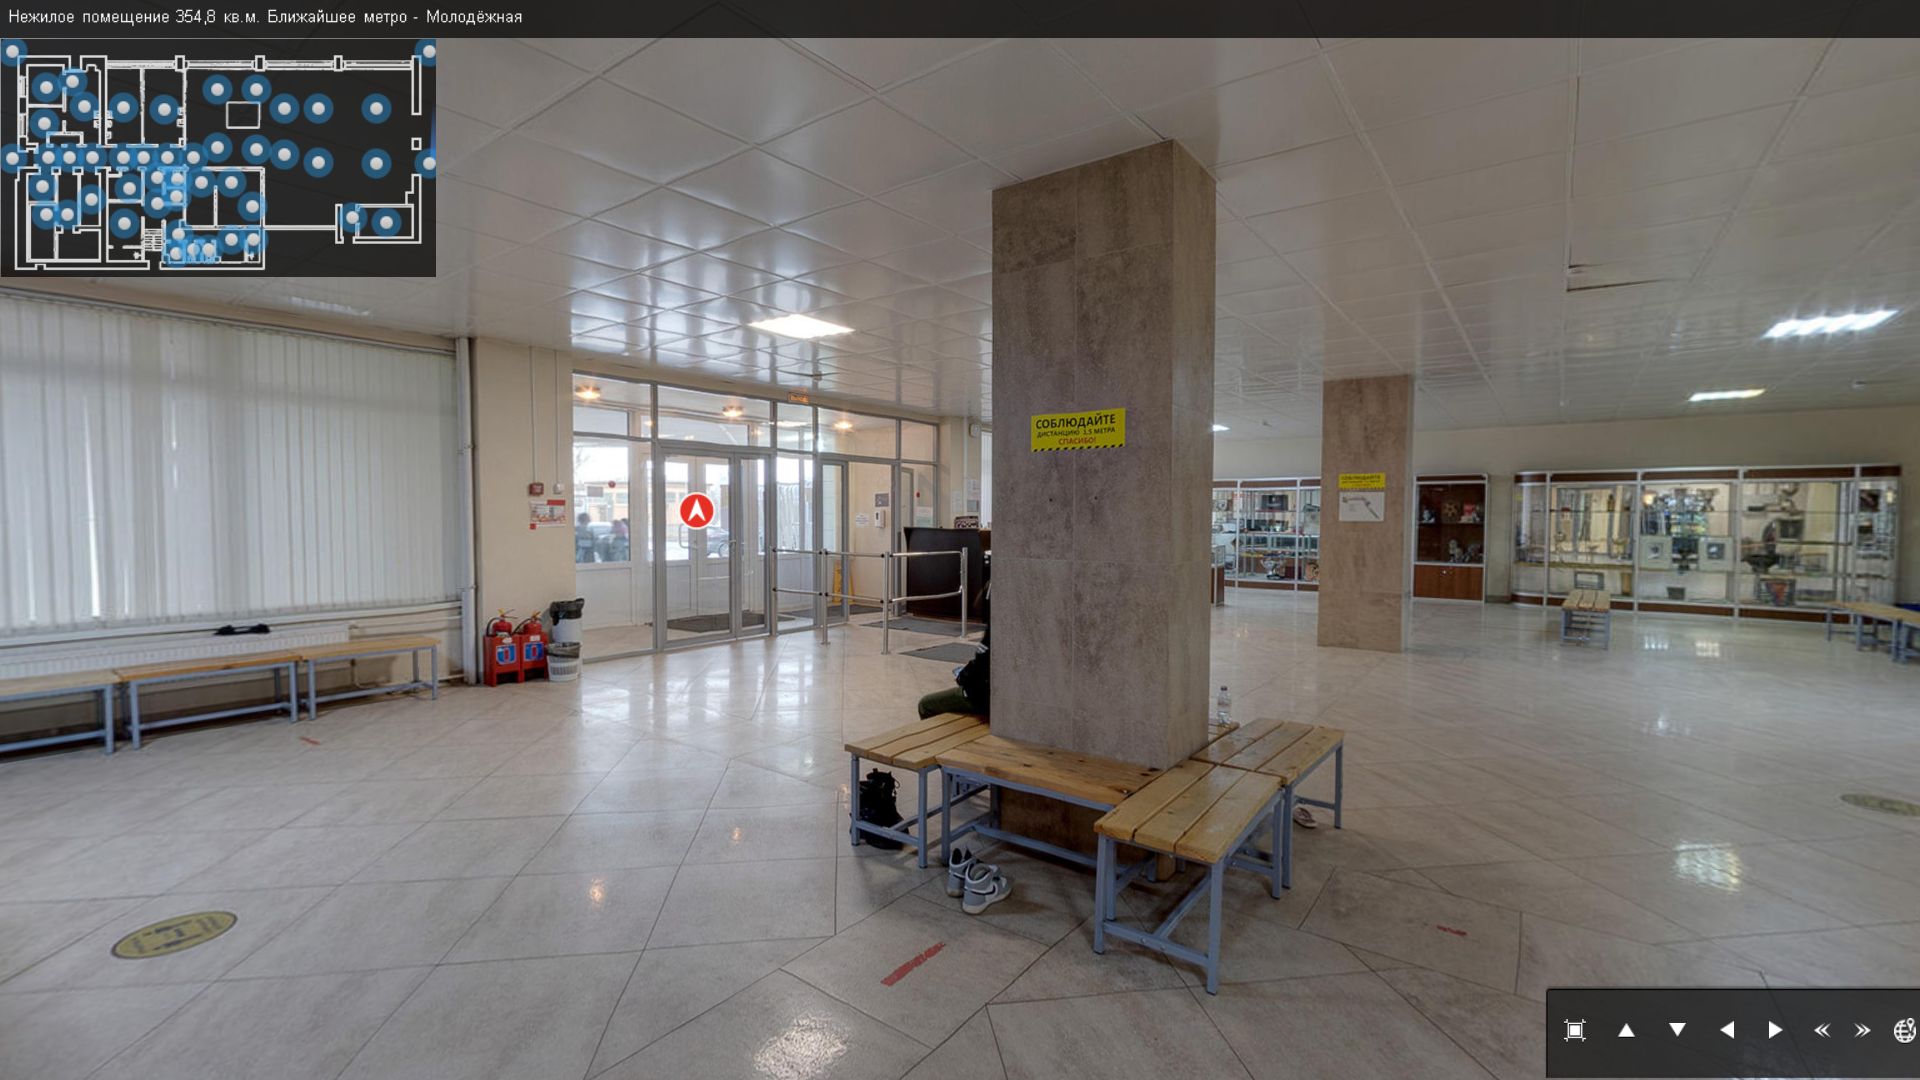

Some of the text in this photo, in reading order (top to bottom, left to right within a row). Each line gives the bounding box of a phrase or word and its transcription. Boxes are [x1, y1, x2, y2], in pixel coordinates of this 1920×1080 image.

[1036, 413, 1116, 429] СОБЛЮДАЙТЕ
[1036, 429, 1080, 438] ДИСТАНЦИЮ
[1058, 437, 1096, 445] СПАСИБО!
